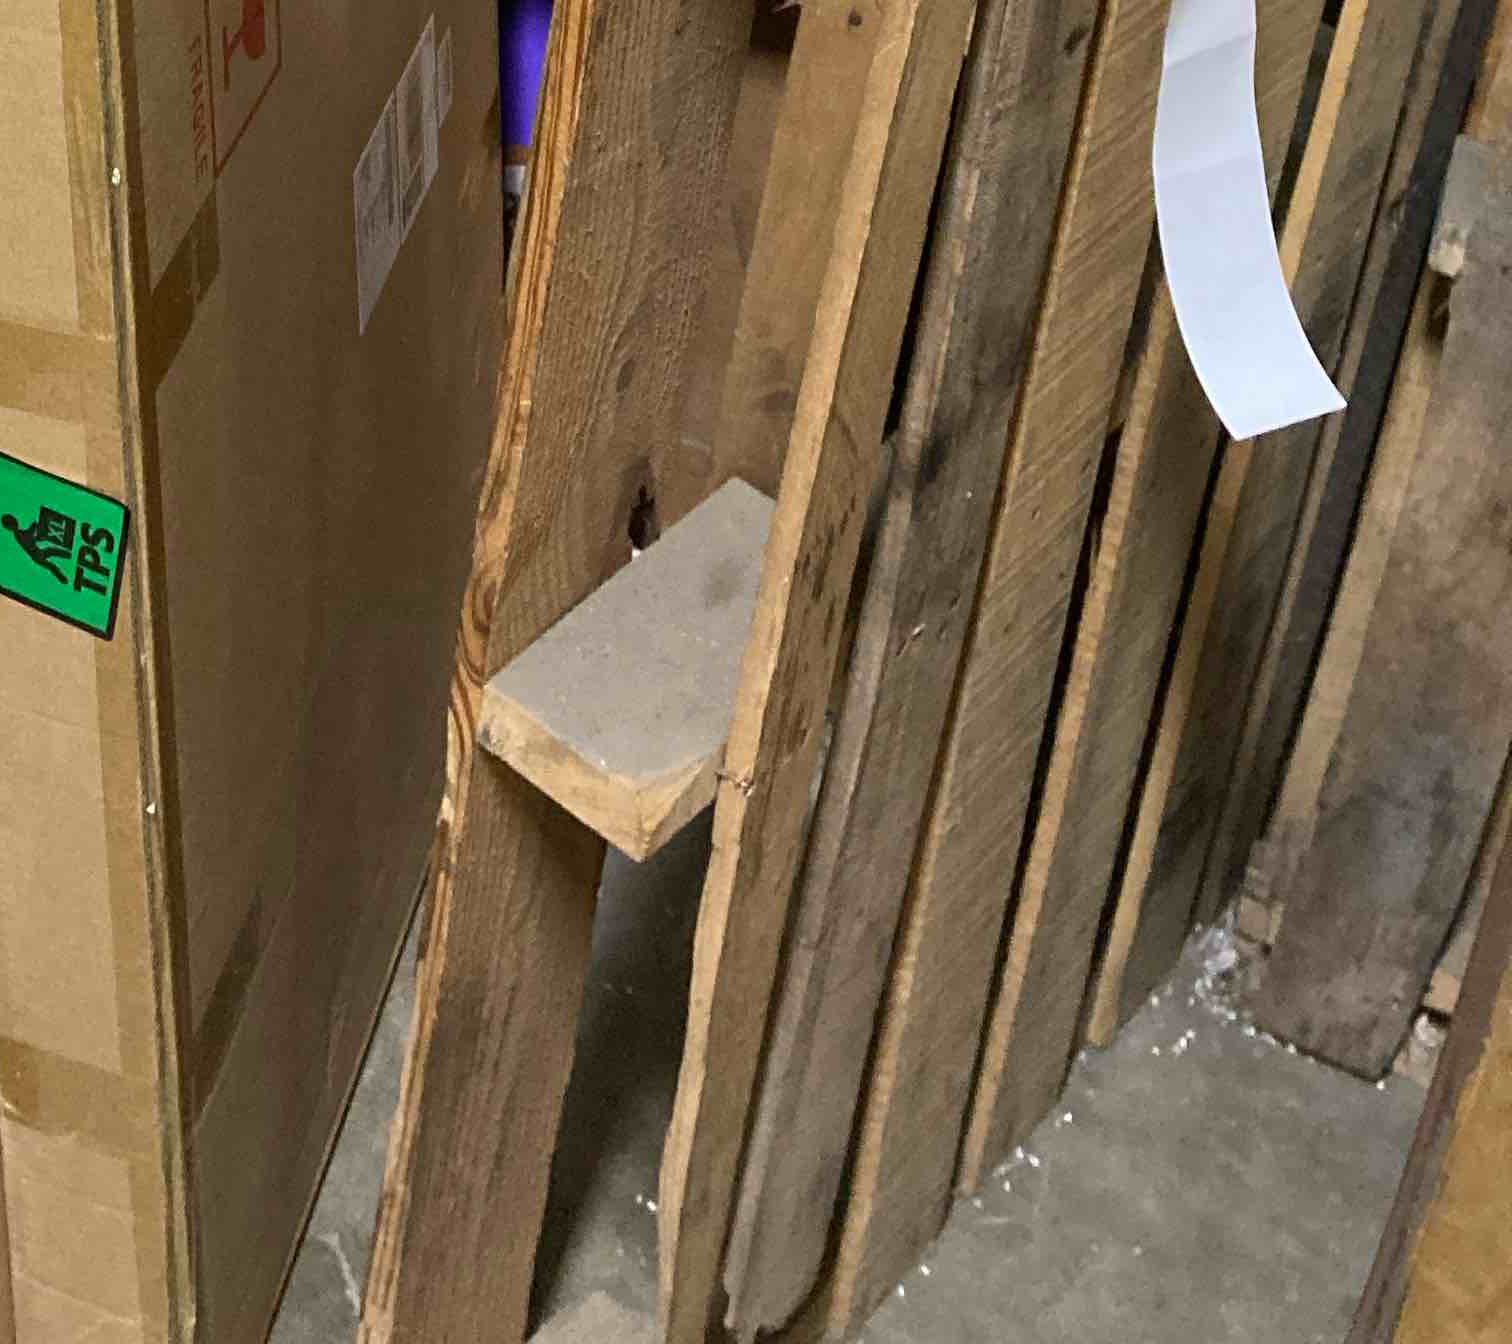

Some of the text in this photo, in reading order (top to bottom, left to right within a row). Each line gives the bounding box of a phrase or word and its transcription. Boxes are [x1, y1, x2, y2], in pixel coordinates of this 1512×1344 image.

[187, 35, 211, 182] FRAGILE
[47, 519, 67, 544] XL
[73, 521, 116, 597] TPS
